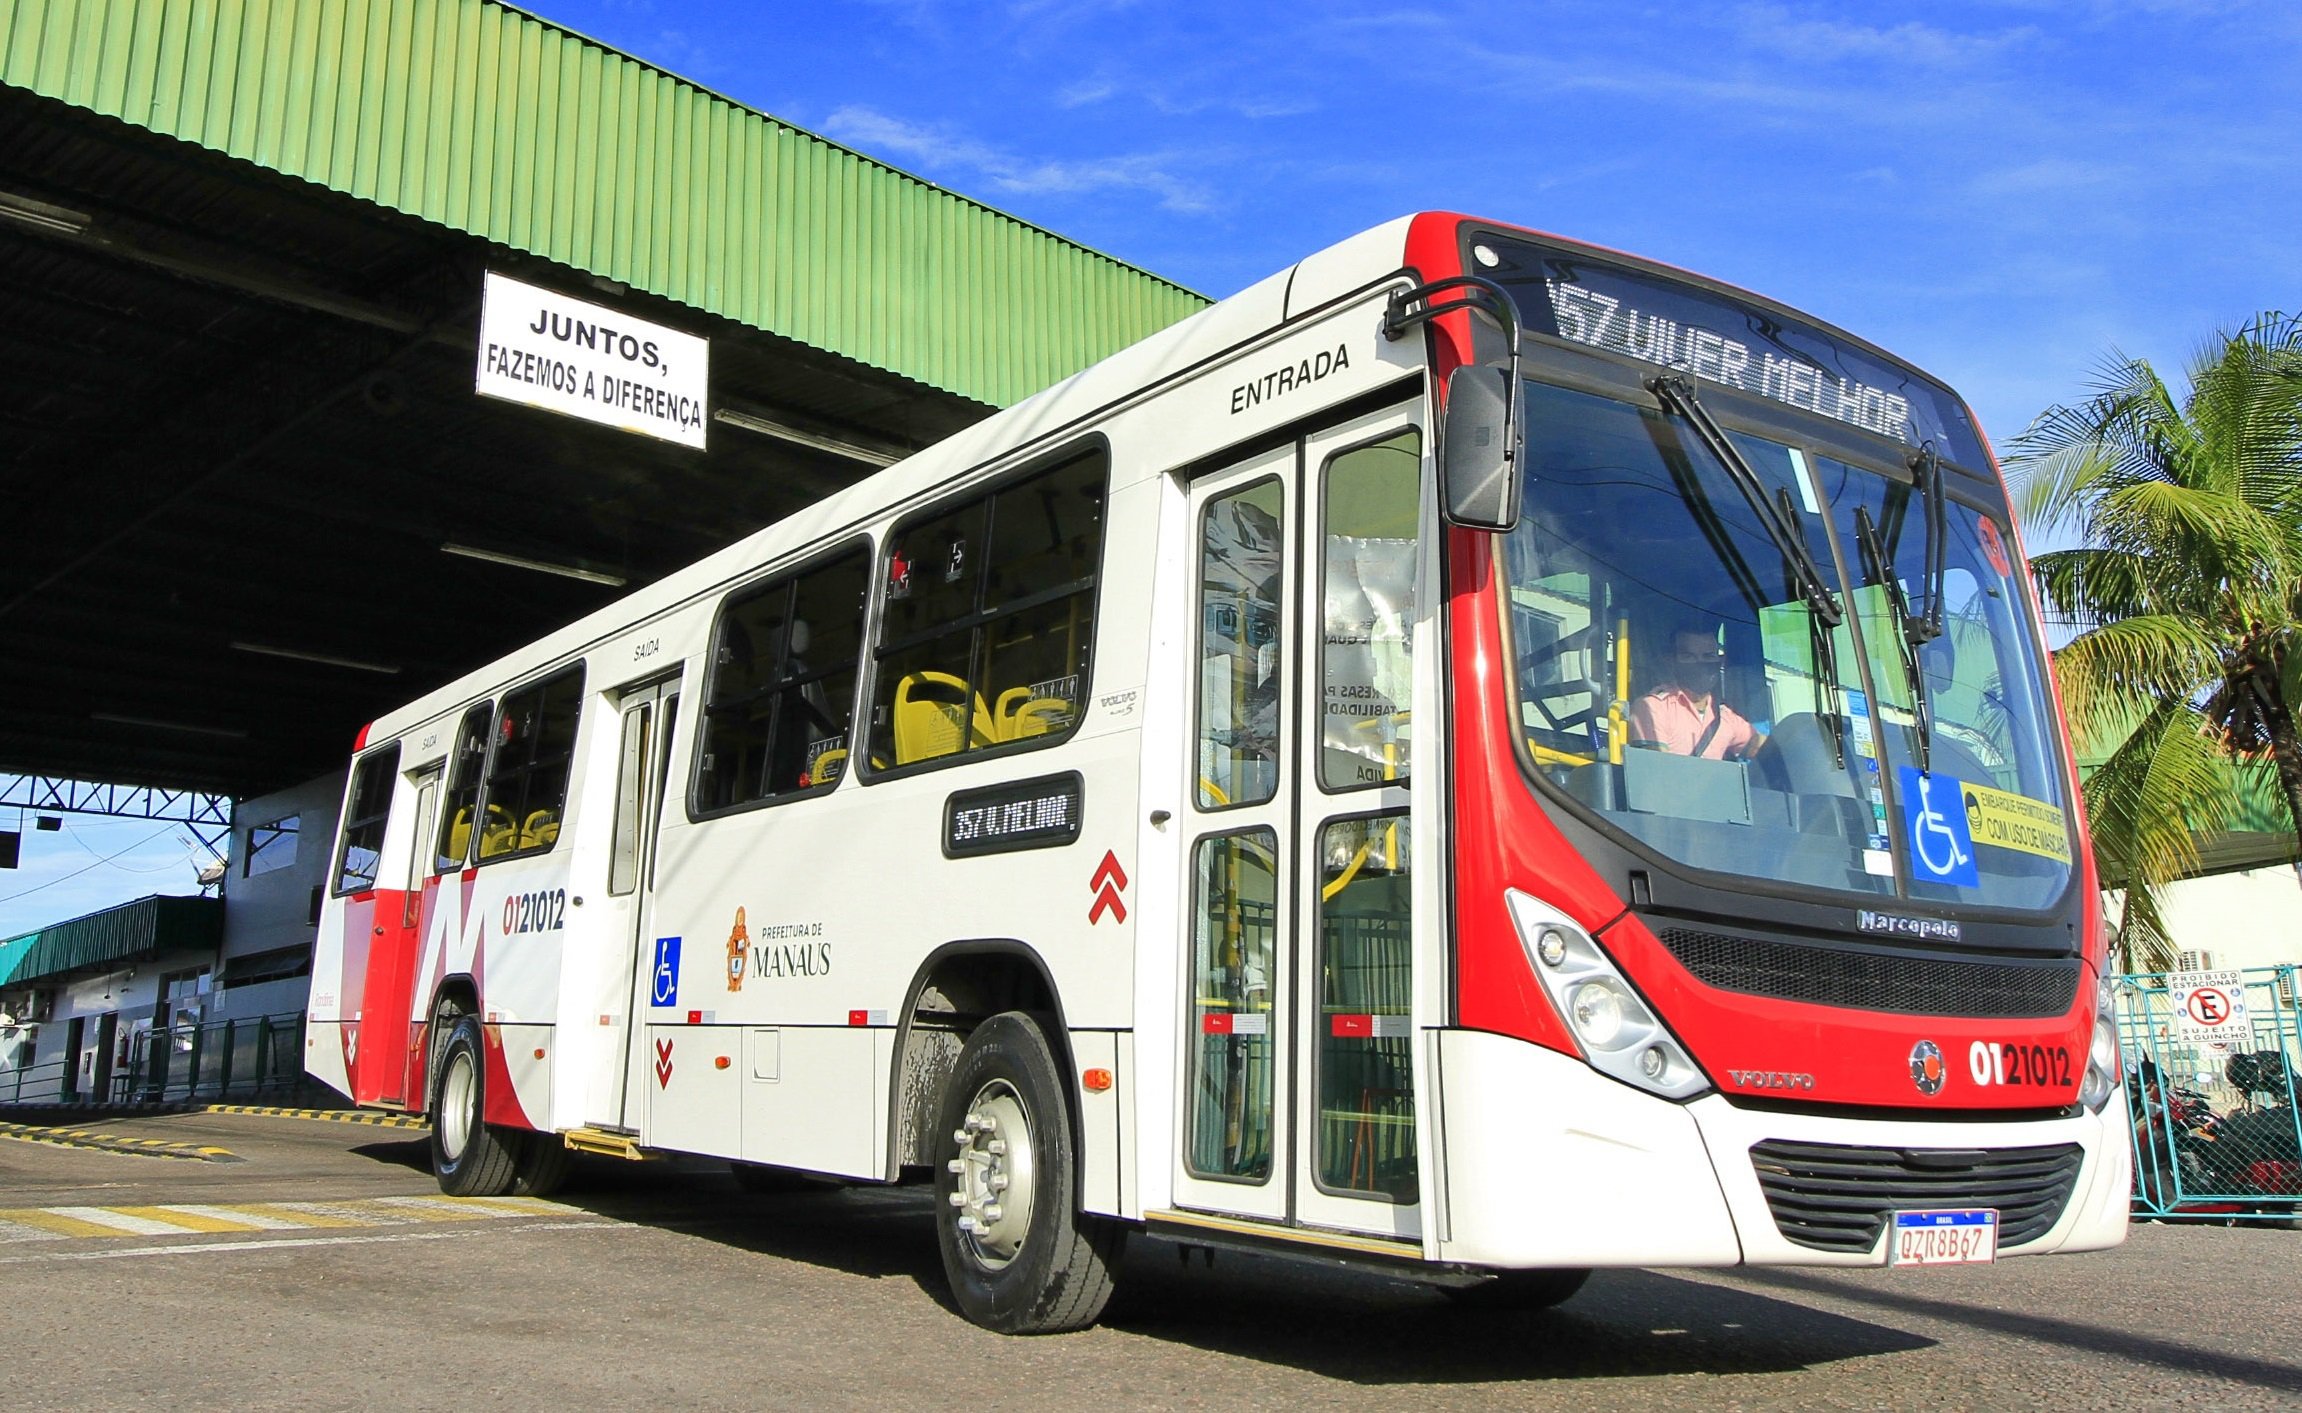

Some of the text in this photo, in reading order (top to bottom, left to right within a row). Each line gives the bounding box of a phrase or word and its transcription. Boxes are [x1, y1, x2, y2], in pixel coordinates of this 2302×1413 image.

[530, 309, 668, 377] JUNTOS,
[487, 343, 701, 432] FAZEMOS A DIFERENÇA
[1230, 343, 1350, 415] ENTRADA
[1762, 352, 1909, 444] MELHOR
[1981, 792, 2017, 814] EMBARQUE
[953, 808, 983, 840] 357
[1986, 817, 2008, 840] COM
[2008, 822, 2027, 846] USO
[2026, 827, 2040, 849] DE
[502, 887, 566, 936] 0121012
[1861, 910, 1959, 938] Marcopolo
[762, 922, 823, 940] PREFEITURA DE
[752, 942, 832, 979] MANAUS
[2172, 972, 2237, 982] PROIBIDO
[2173, 979, 2239, 989] ESTACIONAR
[2182, 1025, 2246, 1034] SUJEITO
[2194, 1032, 2247, 1041] GUINCHO
[1969, 1040, 2072, 1087] 0121012
[1727, 1069, 1815, 1091] VOLVO
[1901, 1228, 1983, 1259] QZR8B67
